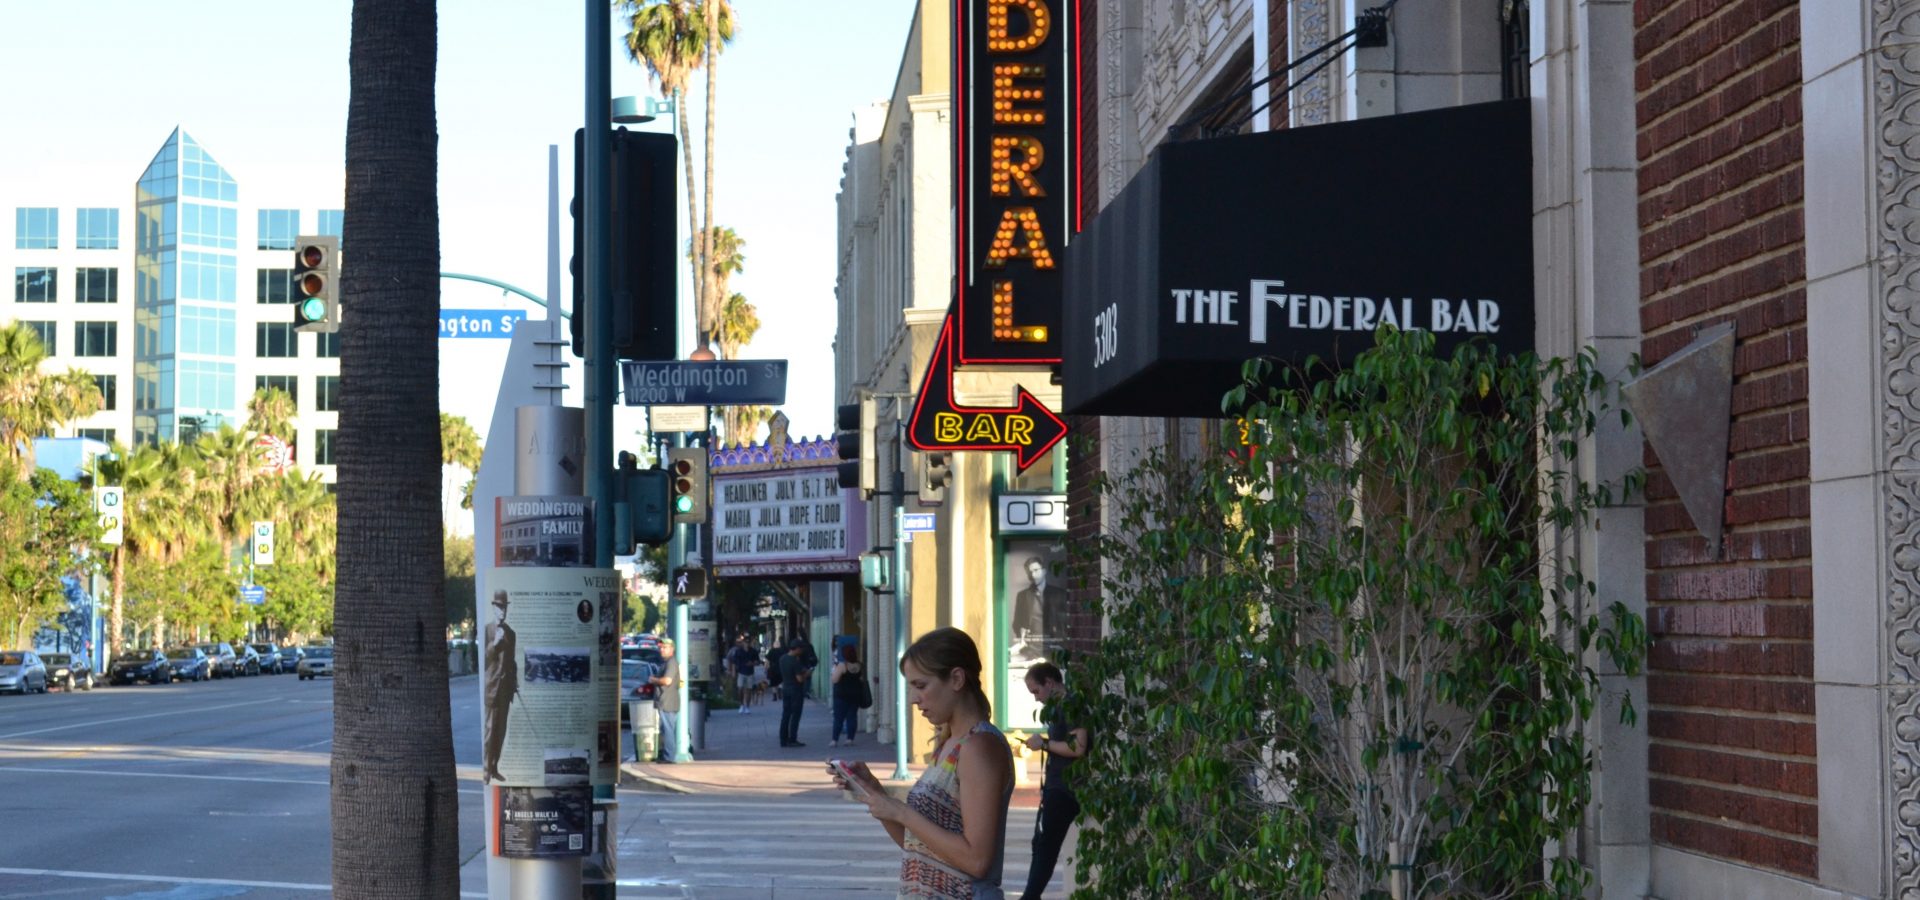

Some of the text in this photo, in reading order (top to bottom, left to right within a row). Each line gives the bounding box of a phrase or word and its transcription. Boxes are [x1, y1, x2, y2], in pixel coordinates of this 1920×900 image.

[1171, 279, 1500, 344] THE FEDERAL BAR
[1094, 302, 1118, 369] 5303
[630, 363, 780, 393] Weddington St
[630, 387, 687, 403] 11200 W
[934, 412, 1035, 445] BAR
[724, 482, 768, 504] HEADLINER
[775, 479, 796, 501] JULY
[824, 476, 838, 497] PM
[507, 501, 584, 516] WEDDINGTON
[724, 503, 841, 529] MARIA JULIA HOPE FLOOD
[542, 520, 585, 535] FAMILY
[716, 533, 752, 554] MELANIE
[807, 529, 836, 551] BOOGIE
[839, 528, 846, 549] B
